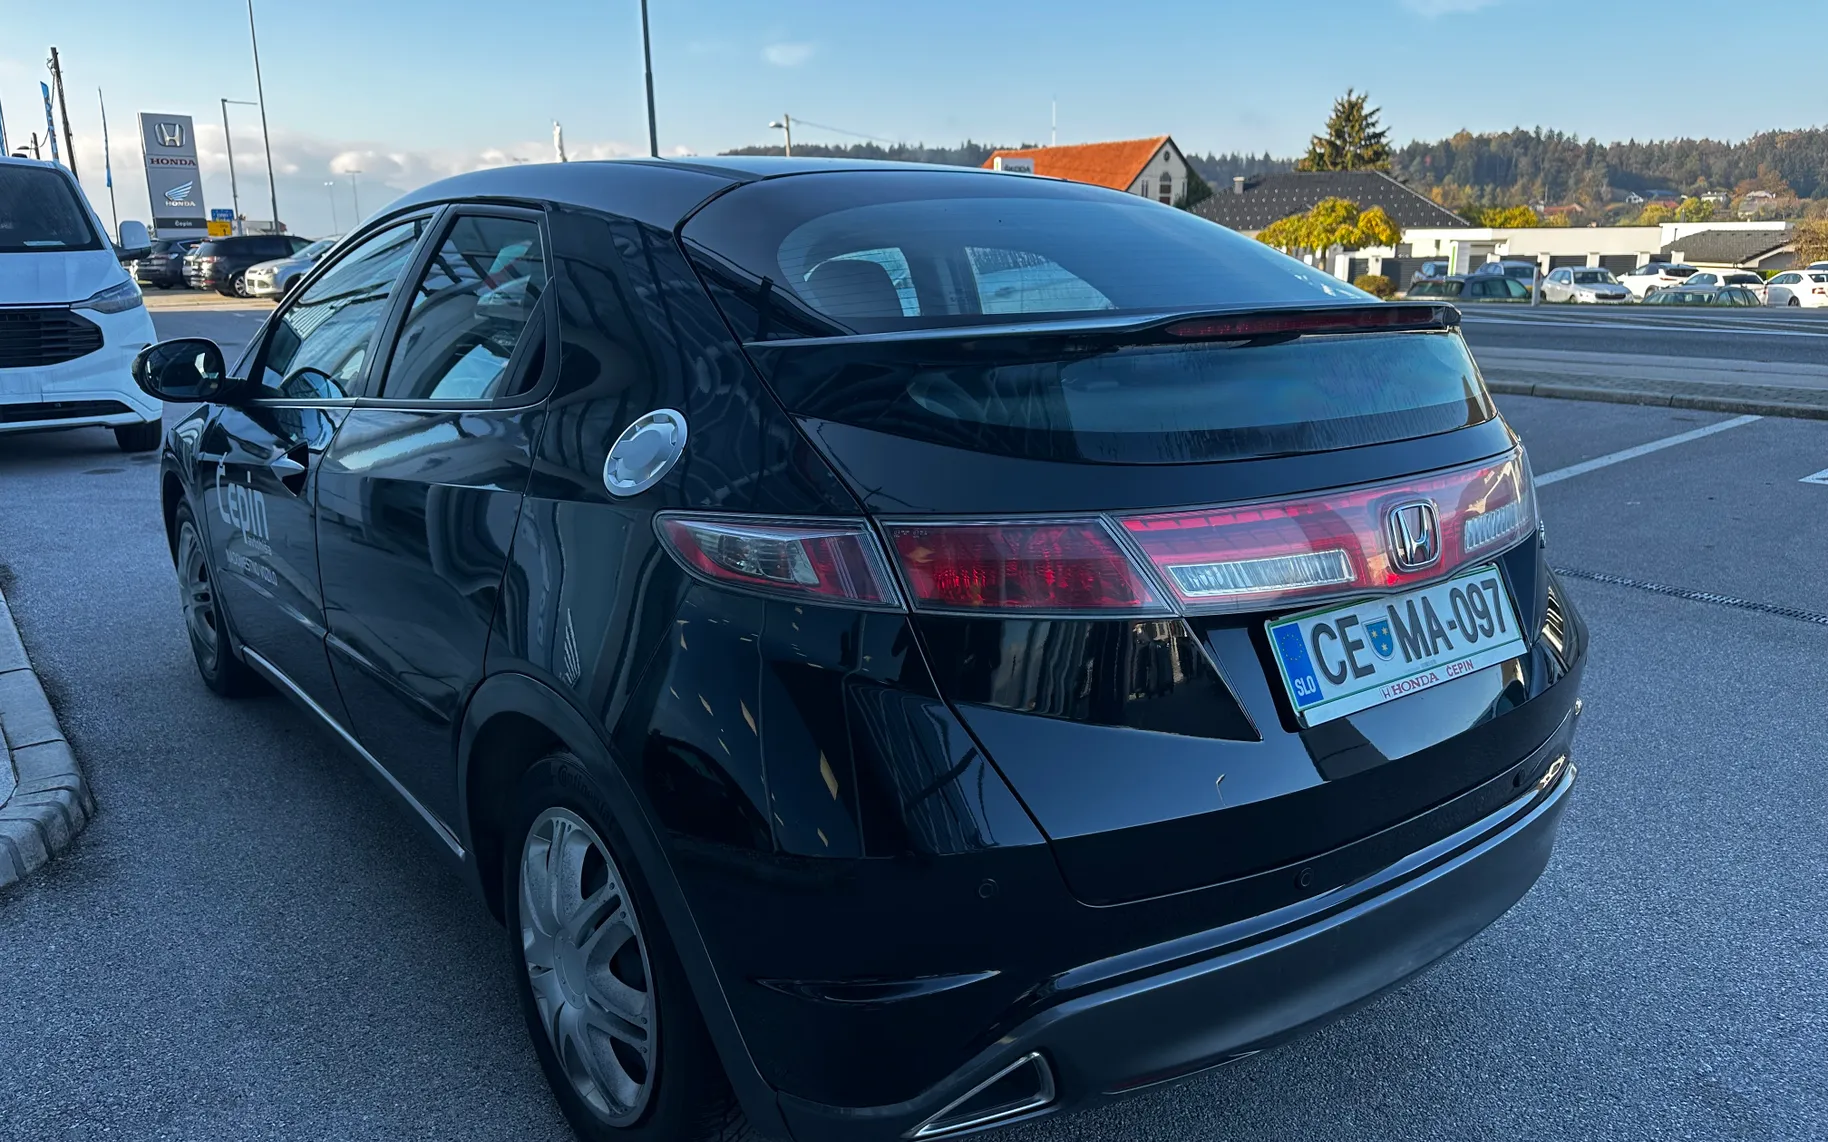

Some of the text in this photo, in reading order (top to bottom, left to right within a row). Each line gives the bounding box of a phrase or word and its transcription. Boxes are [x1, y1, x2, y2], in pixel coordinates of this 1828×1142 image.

[150, 157, 196, 166] HONDA
[1311, 578, 1507, 685] CE MA-097
[1294, 677, 1317, 697] SLO
[1391, 672, 1439, 696] HONDA
[1446, 659, 1474, 677] ČEPIN
